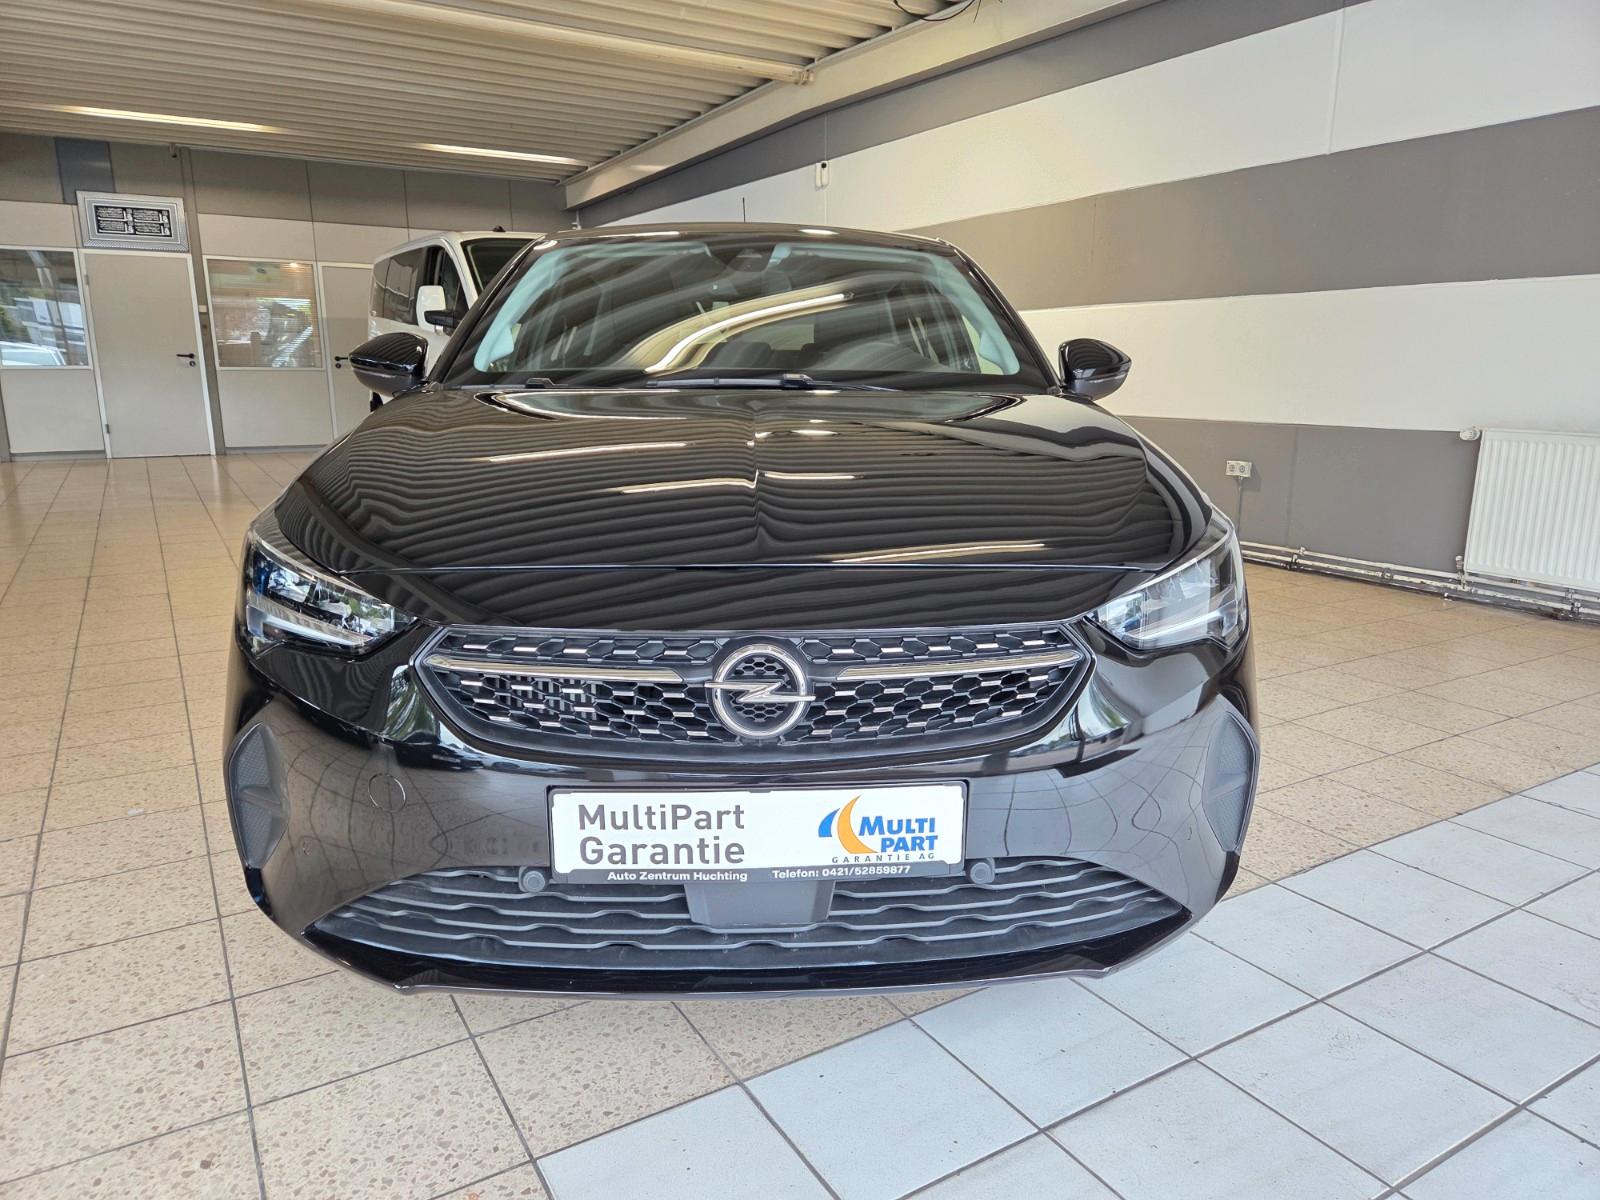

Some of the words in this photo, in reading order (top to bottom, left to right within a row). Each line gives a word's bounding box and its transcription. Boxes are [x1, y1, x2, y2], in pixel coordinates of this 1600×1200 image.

[578, 804, 745, 831] MultiPart
[859, 815, 936, 836] MULTI
[579, 835, 745, 865] Garantie
[880, 835, 938, 853] PART
[831, 854, 910, 864] GARANTIE
[918, 852, 935, 861] AG
[607, 871, 637, 881] Auto
[639, 871, 690, 881] Zentrum
[693, 871, 748, 882] Huchting
[772, 868, 819, 879] Telefon:
[822, 865, 911, 878] 0421/52859877
